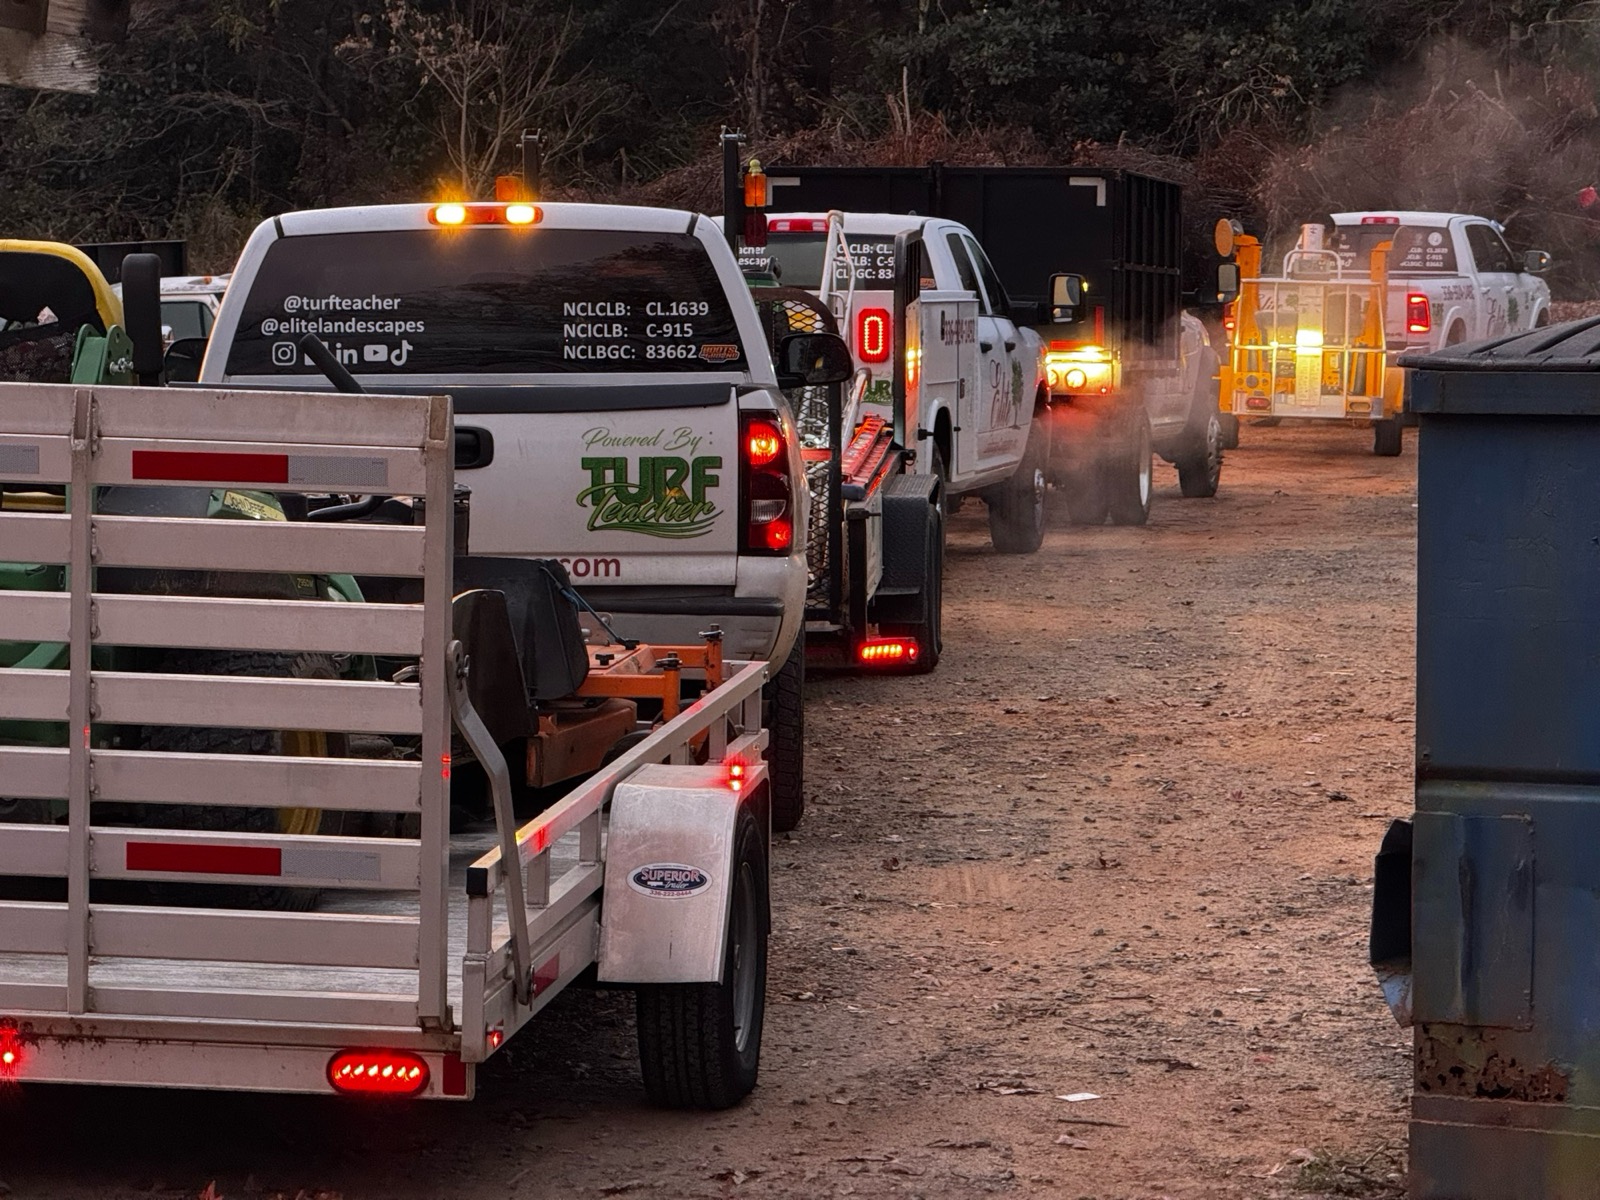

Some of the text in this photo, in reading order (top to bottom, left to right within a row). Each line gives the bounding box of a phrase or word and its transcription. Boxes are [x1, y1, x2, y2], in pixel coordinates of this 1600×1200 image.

[284, 295, 401, 313] @turfteacher
[563, 301, 709, 316] NCLCLB: CL.1639
[261, 317, 425, 336] @elitelandescapes
[563, 323, 693, 338] NCICLB: C-915
[563, 344, 697, 359] NCLBGC: 83662
[581, 426, 665, 451] Powered
[581, 455, 723, 506] TURF
[575, 482, 716, 532] Teacher
[641, 867, 701, 882] SUPERIOR
